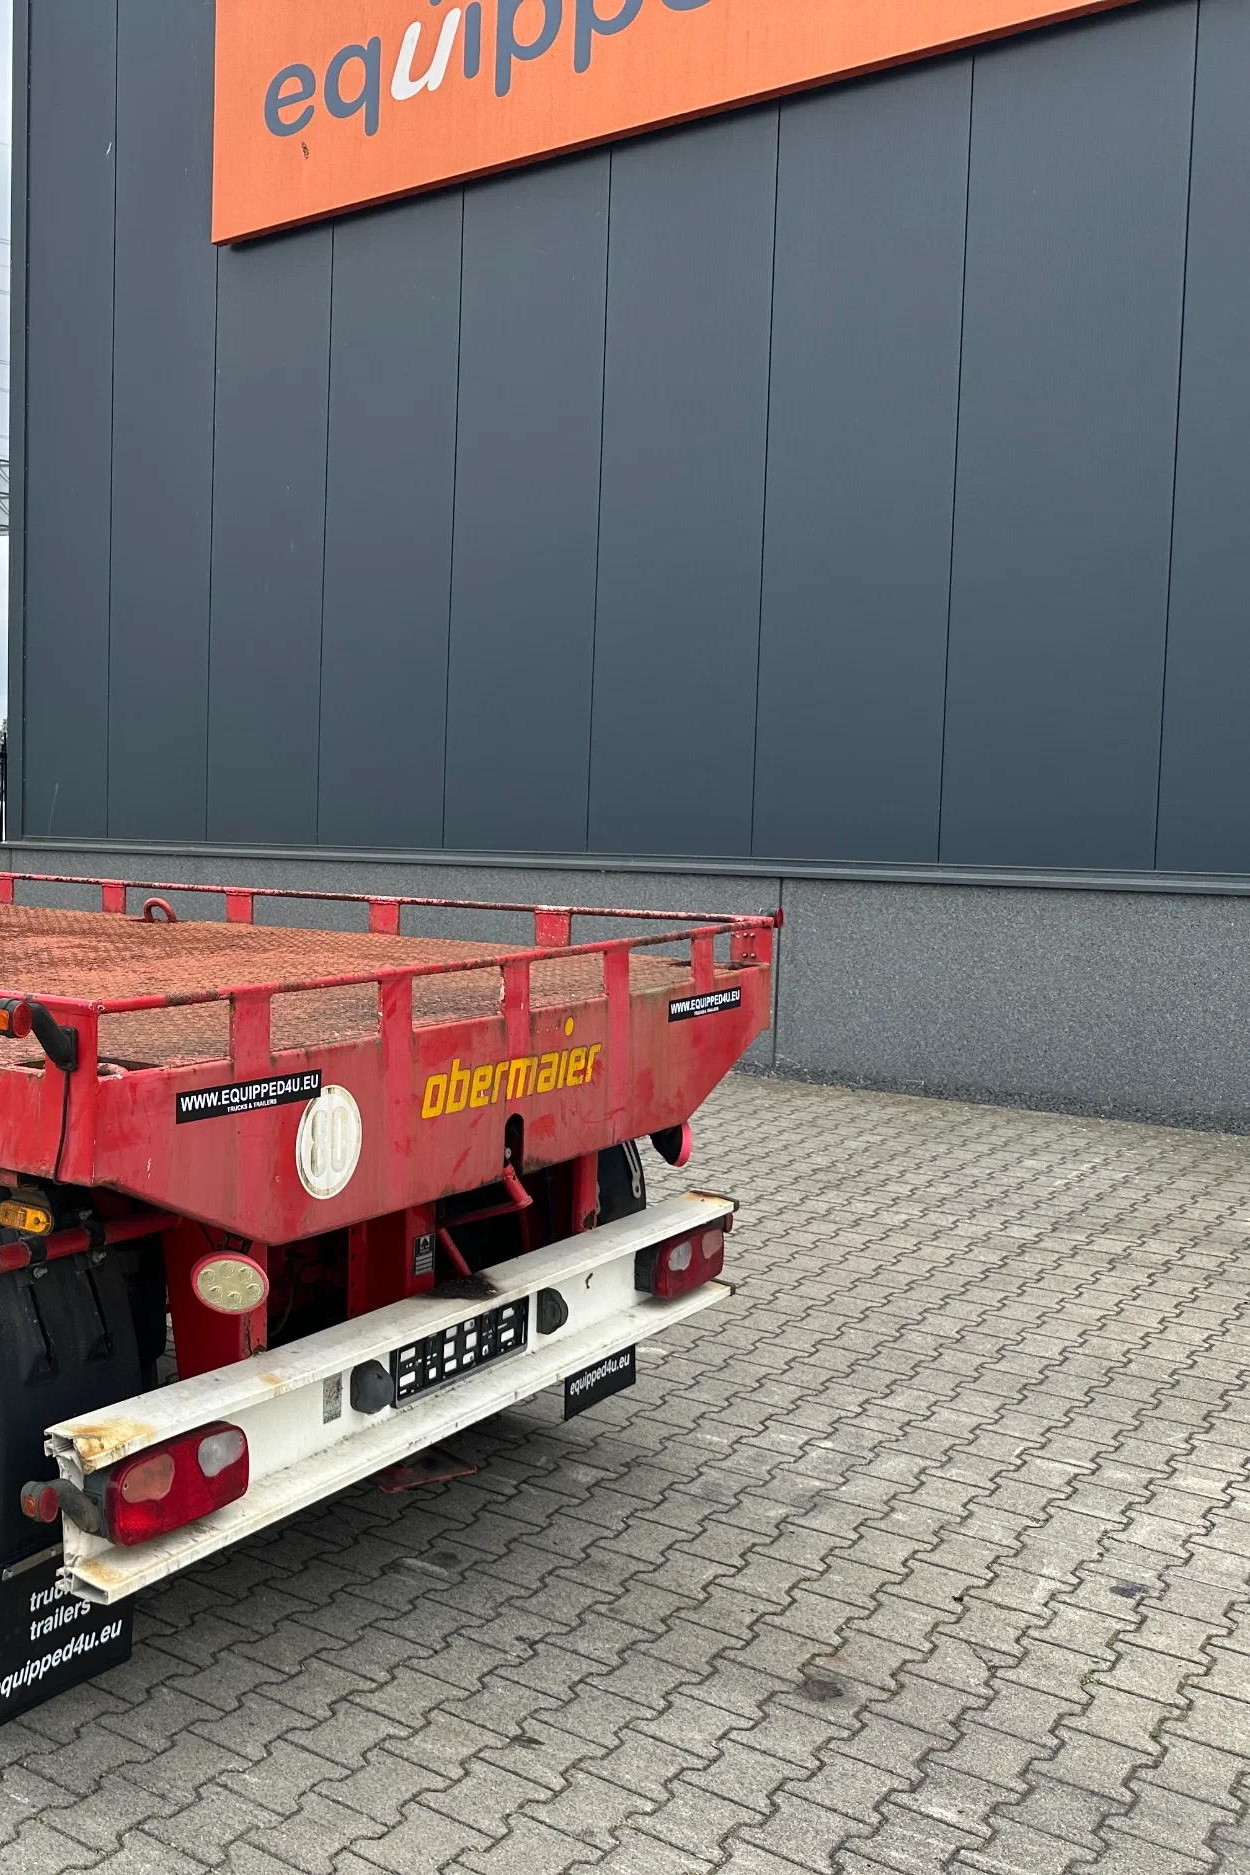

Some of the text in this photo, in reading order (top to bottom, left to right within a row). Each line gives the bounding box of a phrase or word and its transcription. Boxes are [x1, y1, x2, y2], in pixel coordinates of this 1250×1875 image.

[265, 0, 713, 137] equipp
[671, 990, 740, 1014] WWW.EQUIPPED4U.EU
[421, 1018, 602, 1119] obermaier
[180, 1074, 319, 1112] WWW.EQUIPPED4U.EU
[227, 1103, 248, 1112] TRUCKS
[310, 1105, 349, 1178] 80
[570, 1353, 630, 1396] equipped4u.eu
[29, 1599, 91, 1641] trailers
